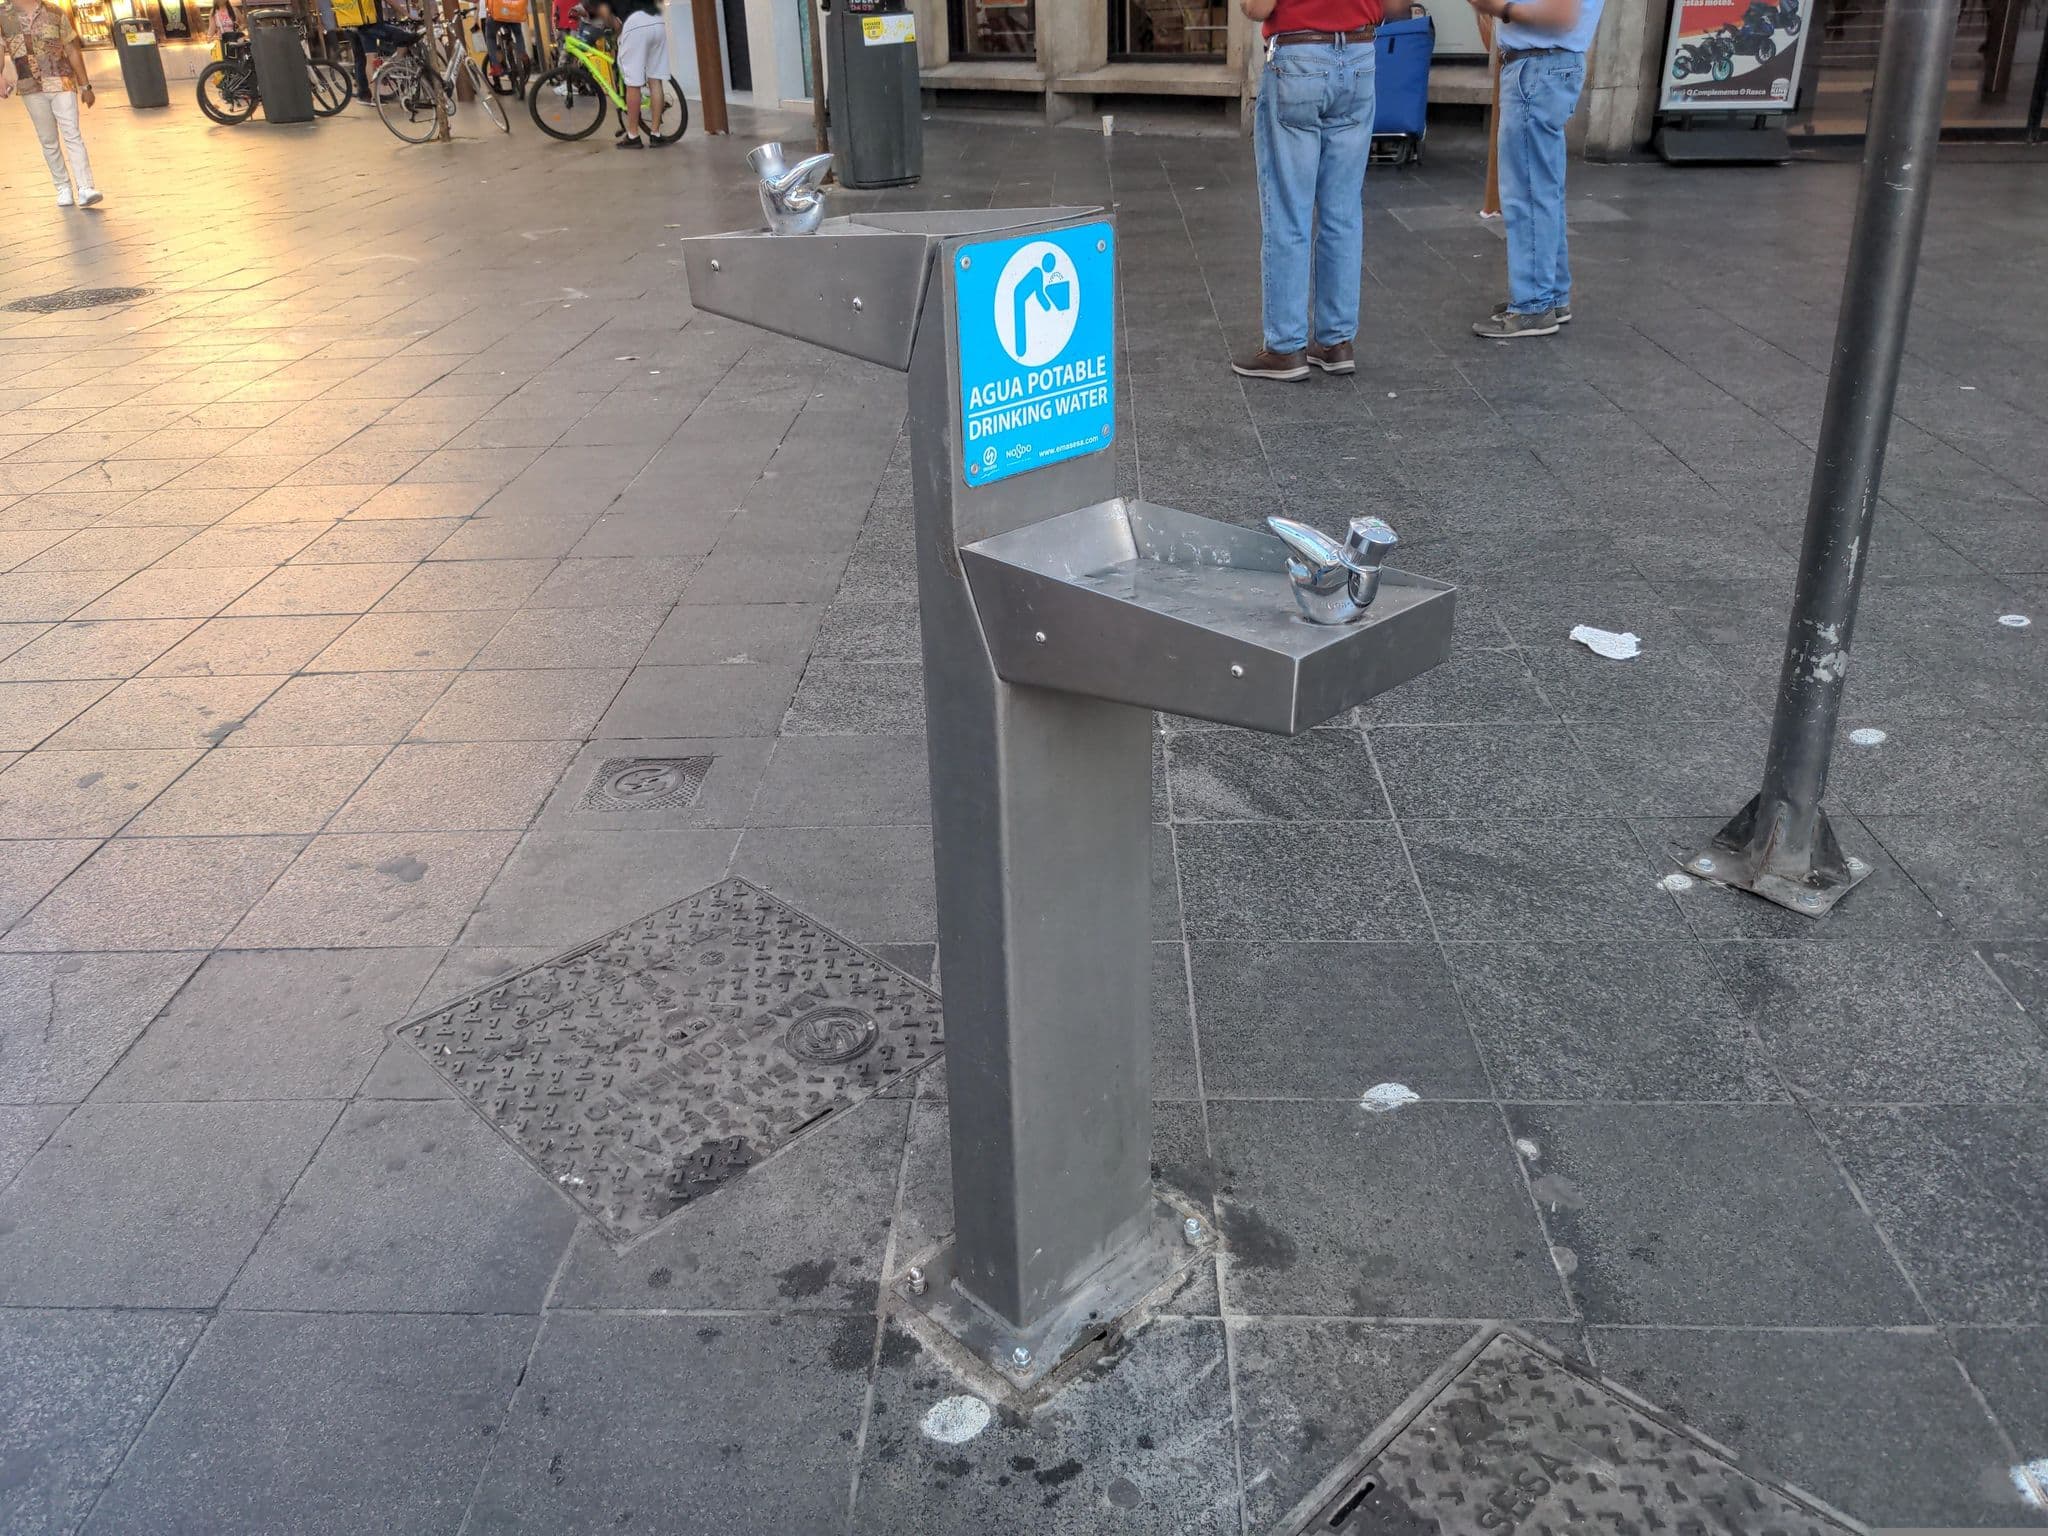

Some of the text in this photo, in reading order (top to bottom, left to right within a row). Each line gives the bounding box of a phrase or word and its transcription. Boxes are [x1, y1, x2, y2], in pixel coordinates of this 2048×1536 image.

[969, 355, 1106, 410] AGUA POTABLE
[969, 386, 1108, 440] DRINKING WATER
[1038, 435, 1099, 458] www.emasesa.com
